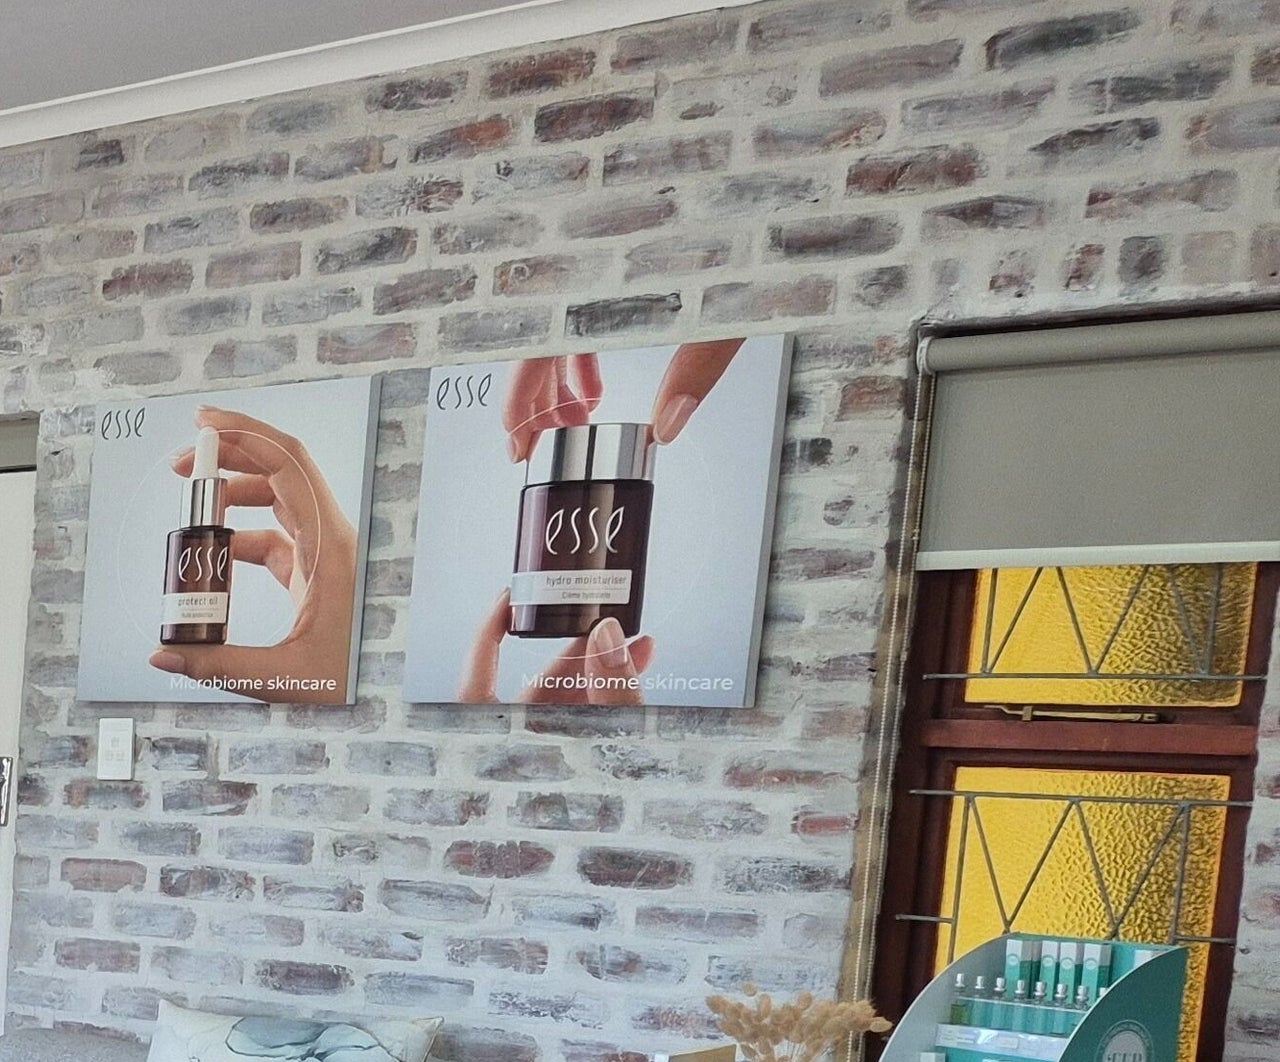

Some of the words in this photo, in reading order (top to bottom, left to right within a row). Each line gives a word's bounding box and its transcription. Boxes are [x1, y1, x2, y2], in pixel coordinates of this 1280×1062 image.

[437, 373, 492, 410] esse
[101, 407, 146, 440] esse
[545, 506, 625, 555] esse
[178, 546, 228, 582] esse
[169, 674, 264, 691] Microbiome
[266, 674, 338, 691] skincare
[521, 672, 640, 690] Microbiome
[644, 673, 734, 690] skincare
